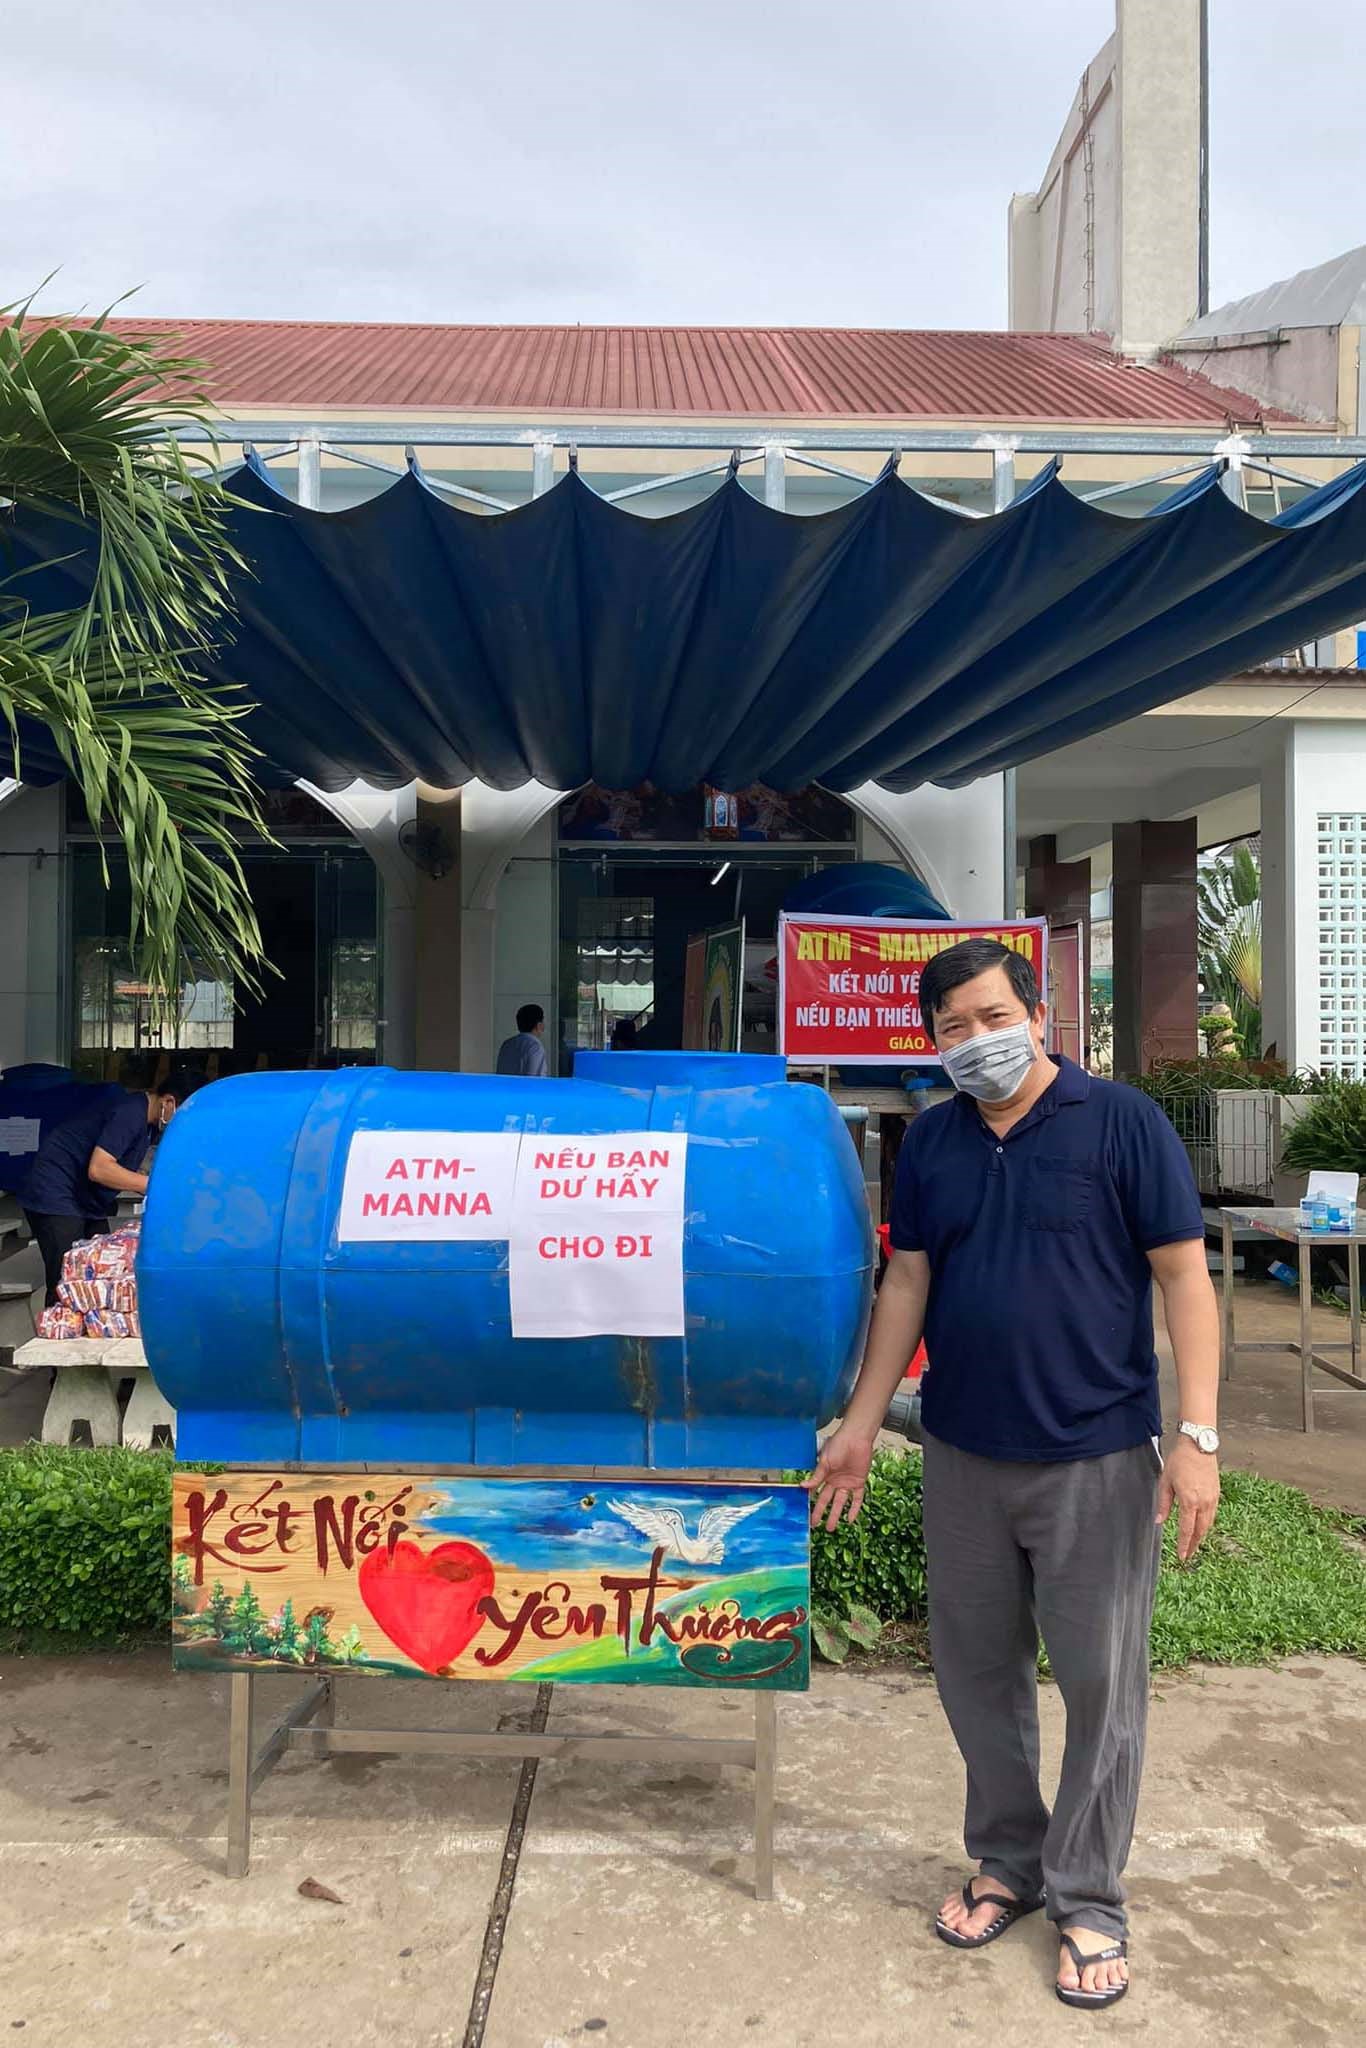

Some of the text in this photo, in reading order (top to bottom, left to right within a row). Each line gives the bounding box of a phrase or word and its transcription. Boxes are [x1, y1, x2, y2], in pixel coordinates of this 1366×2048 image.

[797, 931, 851, 961] ATM
[878, 932, 971, 962] MANN
[982, 931, 1033, 962] AO
[828, 967, 921, 994] KẾT NỐI YÊ
[796, 1001, 923, 1032] NẾU BẠN THIẾU
[889, 1033, 926, 1050] GIÁO
[385, 1158, 476, 1180] ATM-
[534, 1147, 670, 1173] NẾU BẠN
[541, 1172, 660, 1199] DƯ HÃY
[362, 1192, 493, 1217] MANNA
[538, 1235, 653, 1259] CHO ĐI
[184, 1480, 413, 1586] Kết Nối
